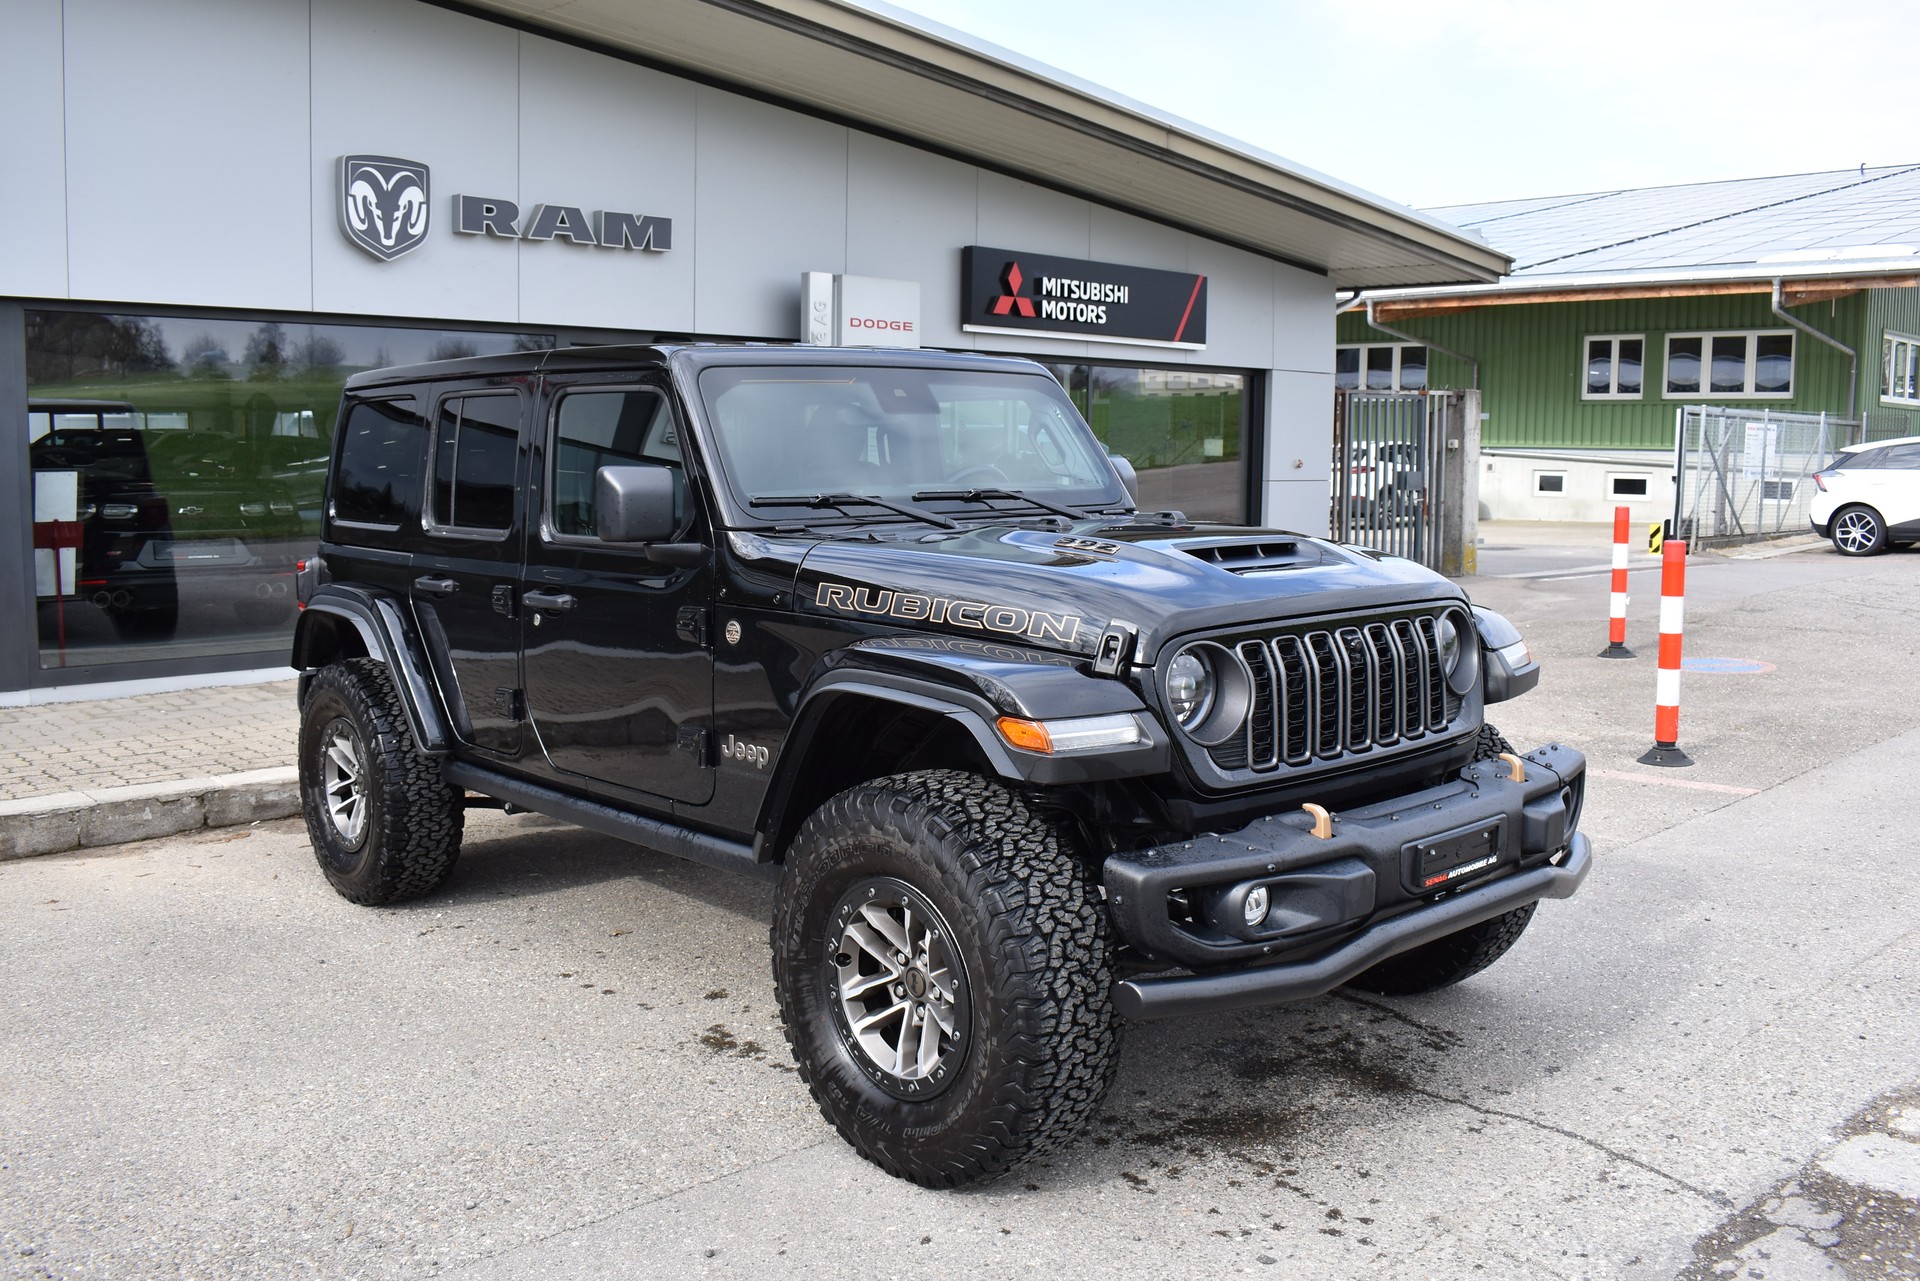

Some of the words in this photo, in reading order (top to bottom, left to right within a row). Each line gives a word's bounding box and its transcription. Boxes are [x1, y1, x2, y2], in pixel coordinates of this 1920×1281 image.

[453, 194, 673, 252] RAM
[1042, 276, 1129, 304] MITSUBISHI
[850, 317, 913, 332] DODGE
[1042, 299, 1107, 324] MOTORS
[1054, 536, 1121, 555] 392
[815, 582, 1080, 643] RUBICON
[721, 734, 770, 769] Jeep
[1448, 861, 1488, 879] AUTOMOBILE
[1488, 856, 1498, 864] AG
